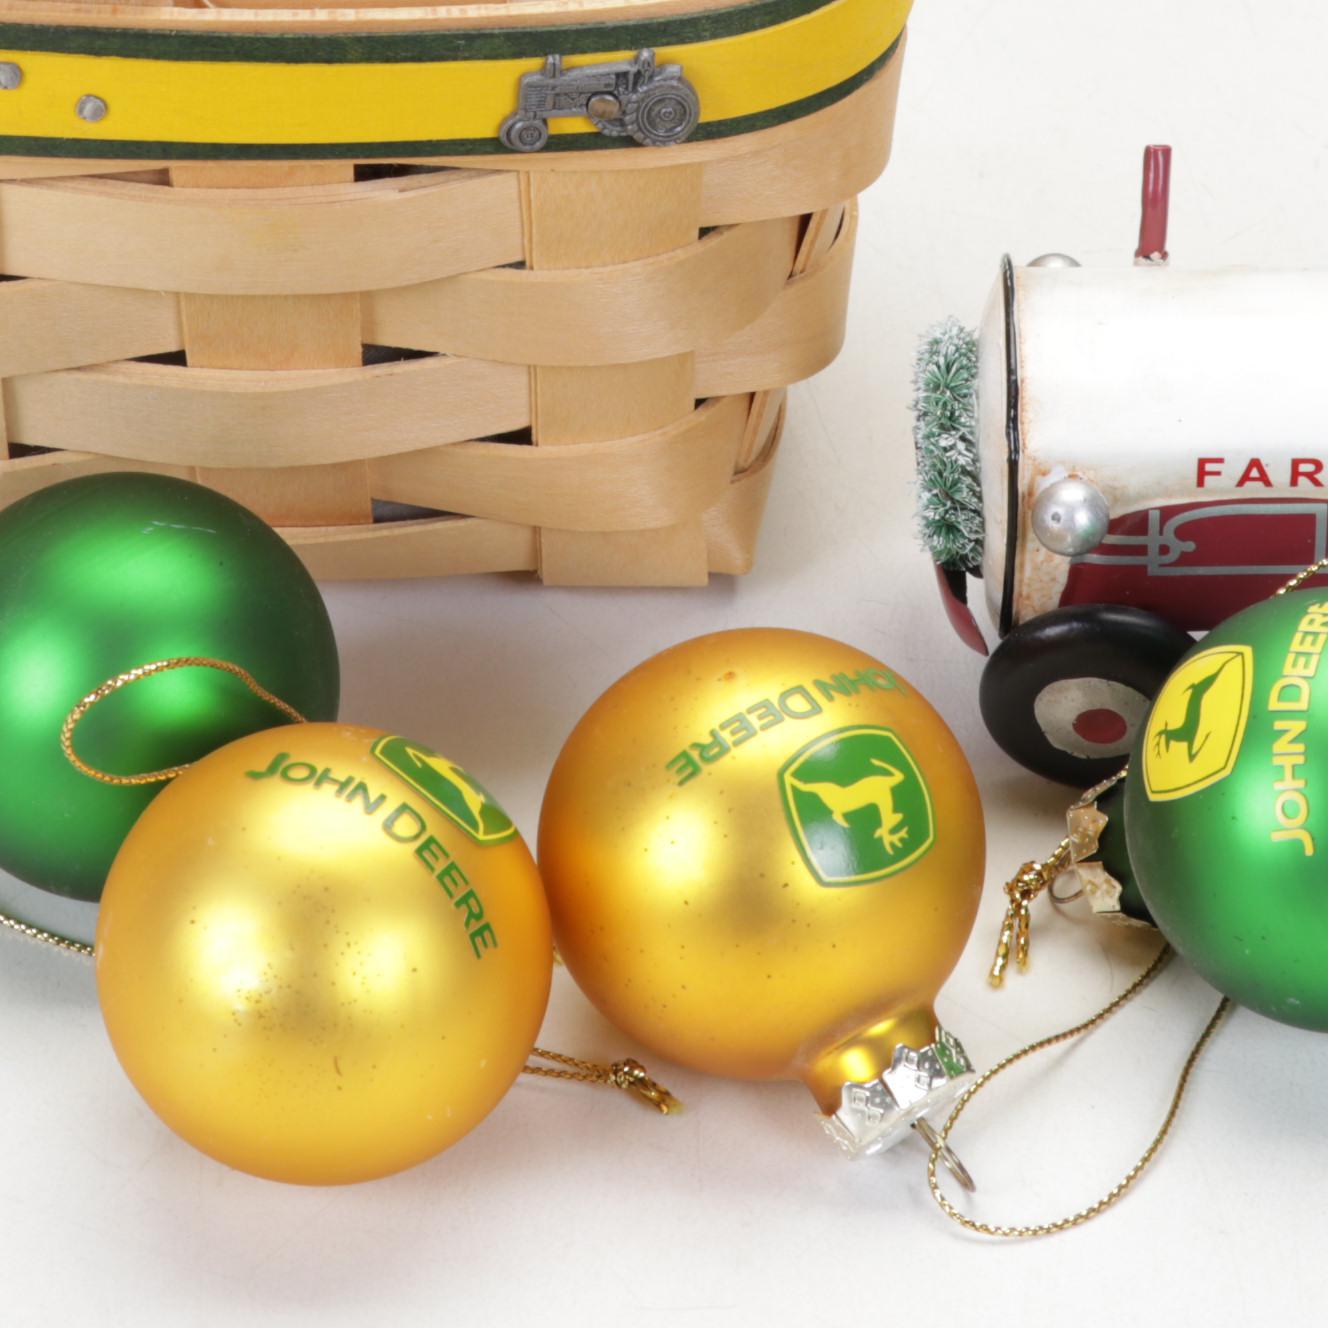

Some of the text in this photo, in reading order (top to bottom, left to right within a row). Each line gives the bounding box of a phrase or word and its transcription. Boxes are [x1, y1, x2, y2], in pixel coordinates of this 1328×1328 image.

[665, 684, 823, 788] DEERE
[1270, 719, 1315, 857] JOHN
[244, 751, 499, 961] JOHN DEERE
